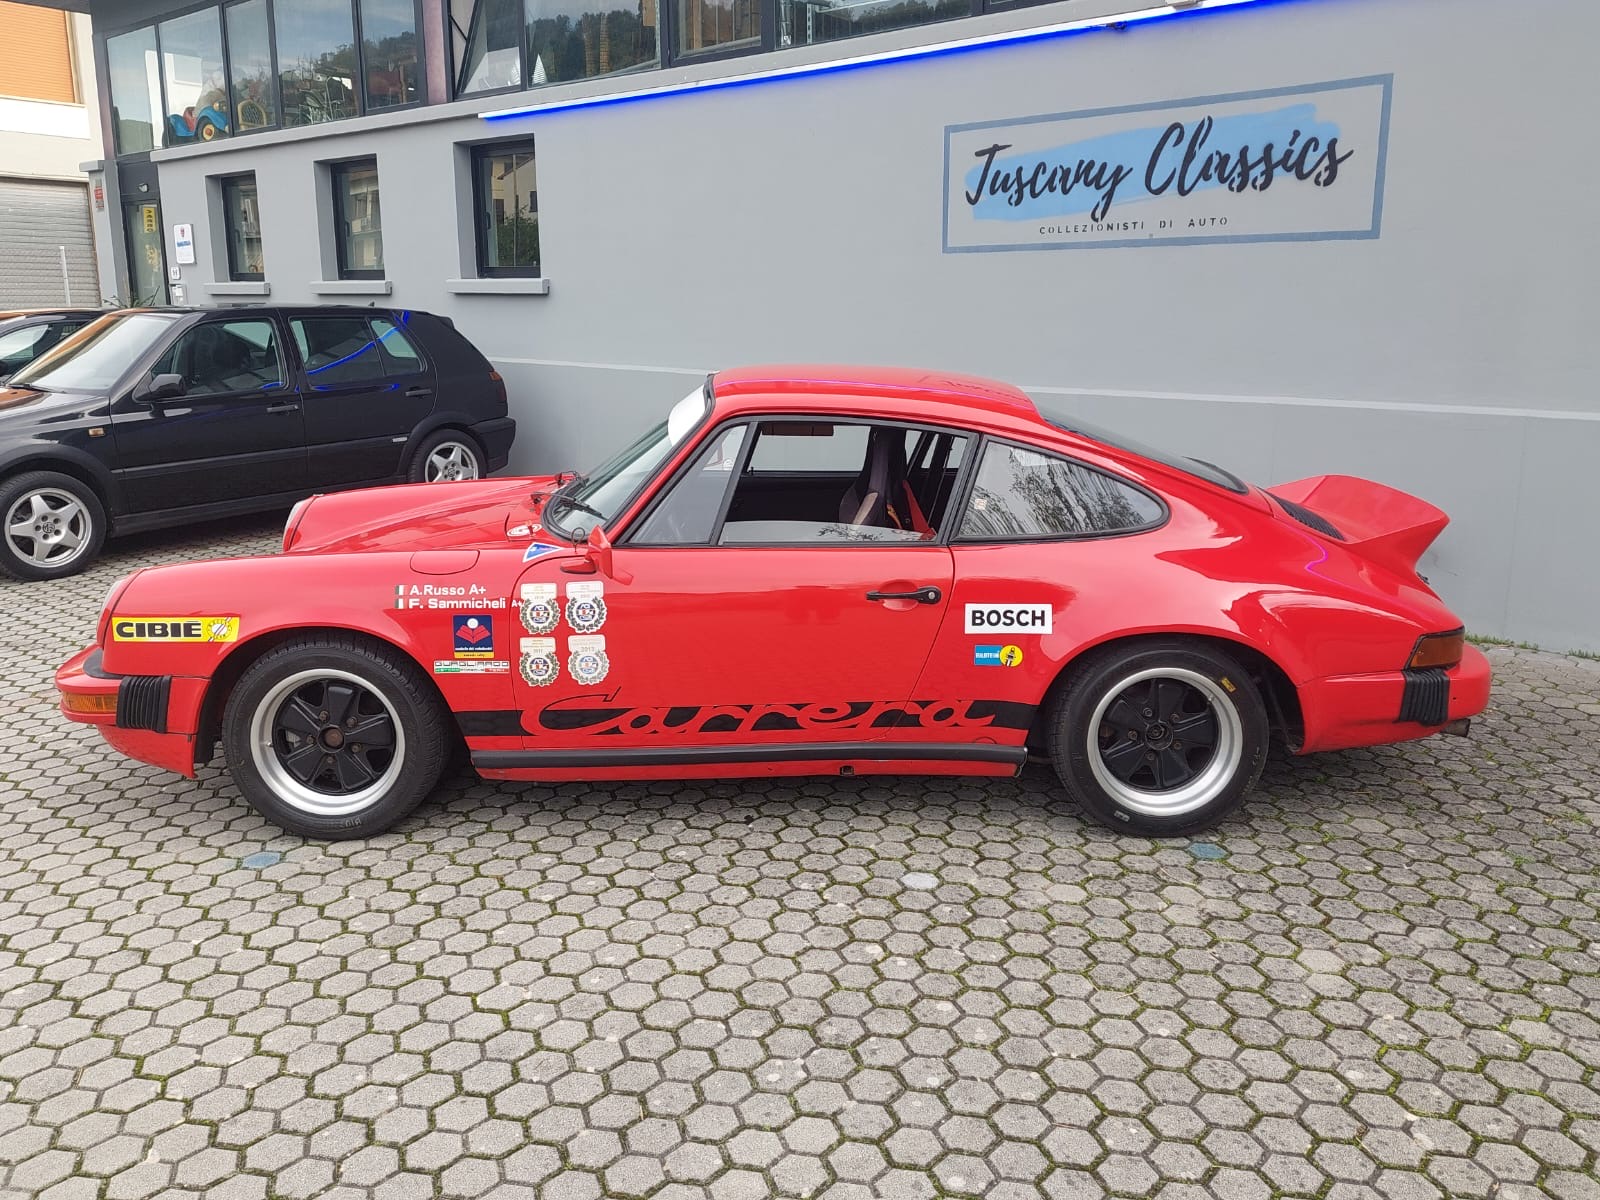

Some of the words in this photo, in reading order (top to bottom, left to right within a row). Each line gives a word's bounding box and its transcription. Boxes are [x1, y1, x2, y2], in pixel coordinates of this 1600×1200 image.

[965, 143, 1133, 223] Tuscany
[1144, 115, 1354, 196] Classics
[1039, 220, 1145, 235] COLLEZIONISTI
[1159, 219, 1173, 229] DI
[1188, 216, 1228, 228] AUTO
[409, 584, 465, 596] A.Russo
[468, 583, 487, 596] A+
[408, 598, 424, 609] F.
[427, 597, 506, 609] Sammicheli
[971, 609, 1045, 627] BOSCH
[519, 686, 995, 737] Carrera
